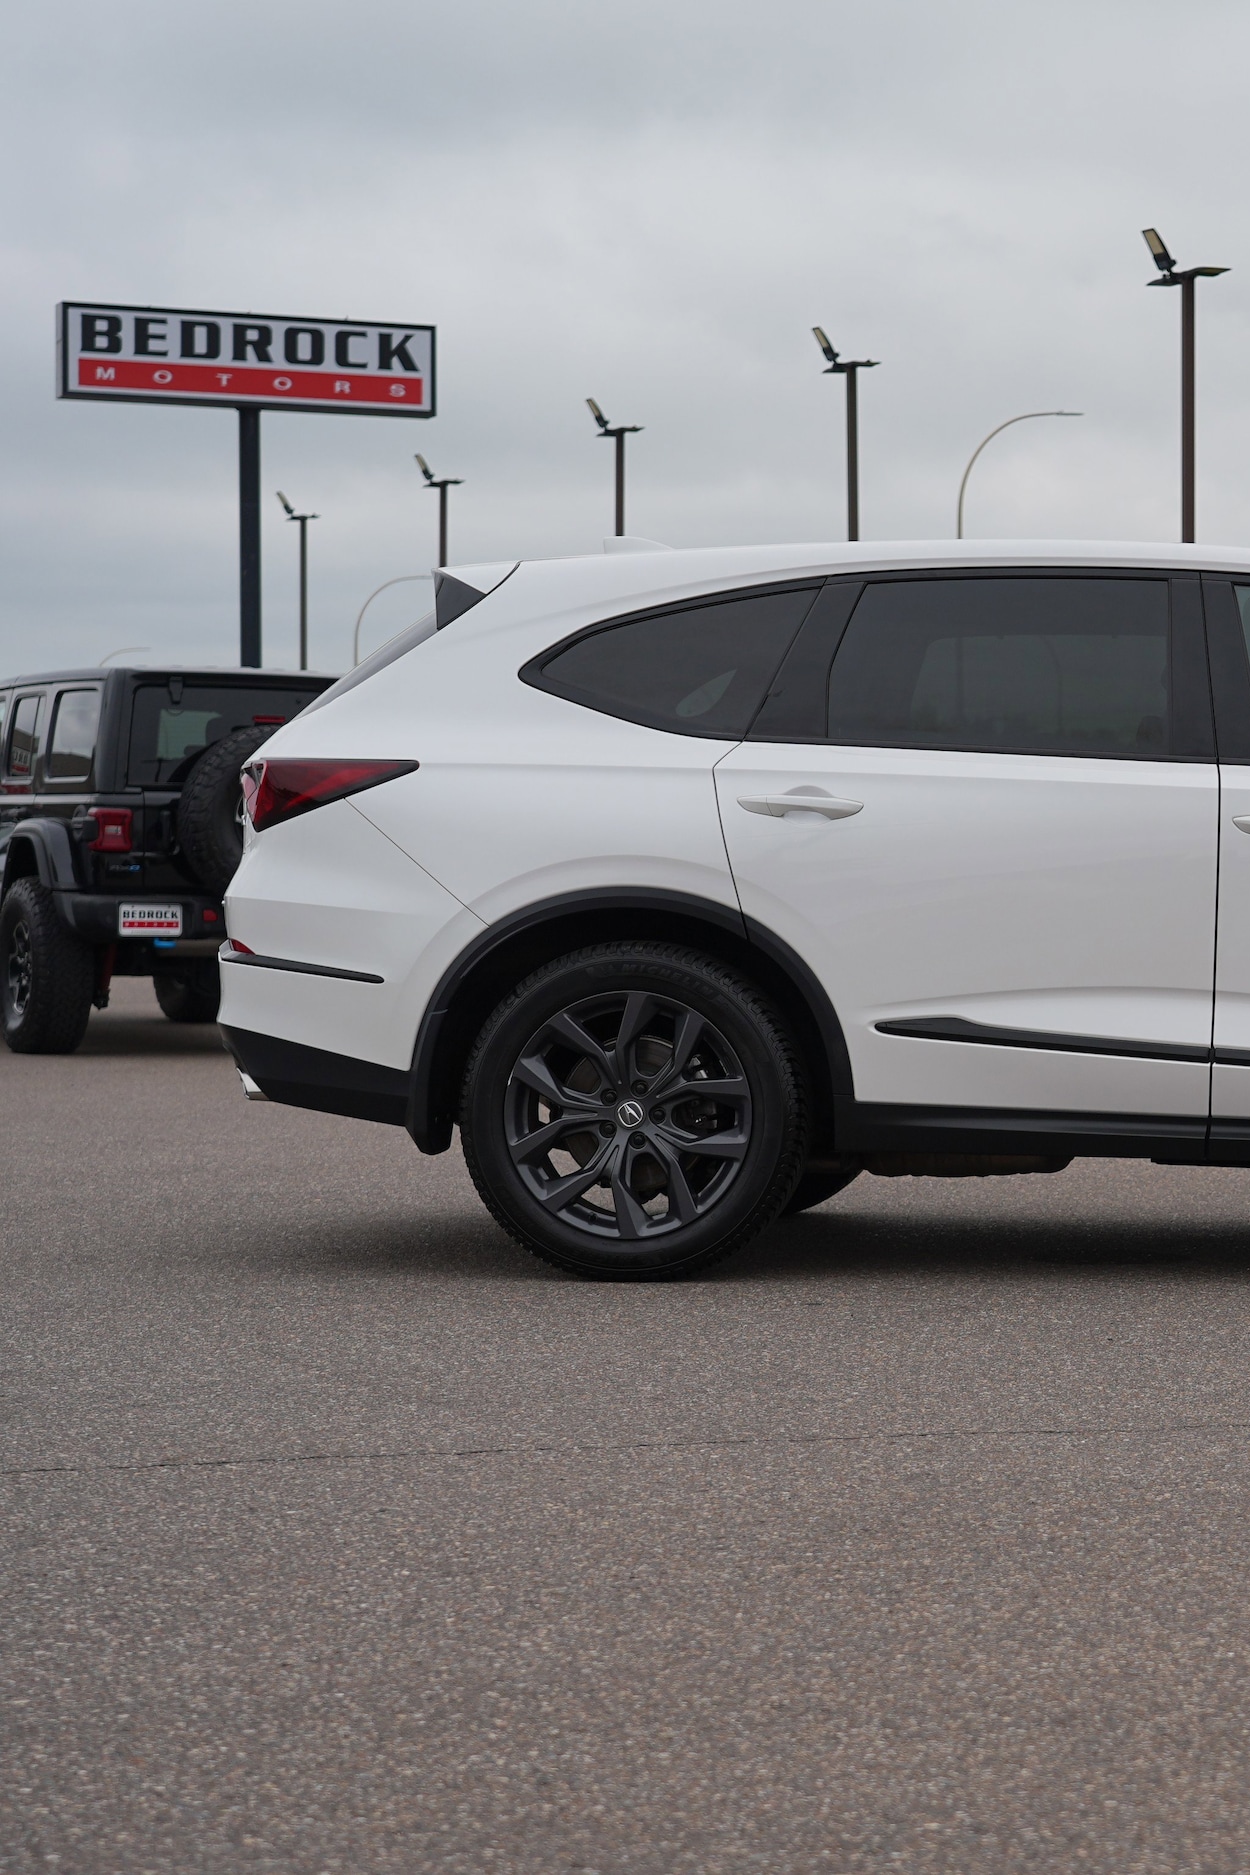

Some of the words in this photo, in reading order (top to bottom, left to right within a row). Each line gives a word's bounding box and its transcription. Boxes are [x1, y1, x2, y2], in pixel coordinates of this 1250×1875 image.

[80, 313, 420, 372] BEDROCK
[95, 365, 407, 398] MOTORS
[122, 909, 179, 919] BEDROCK
[620, 963, 715, 997] MICHELIN
